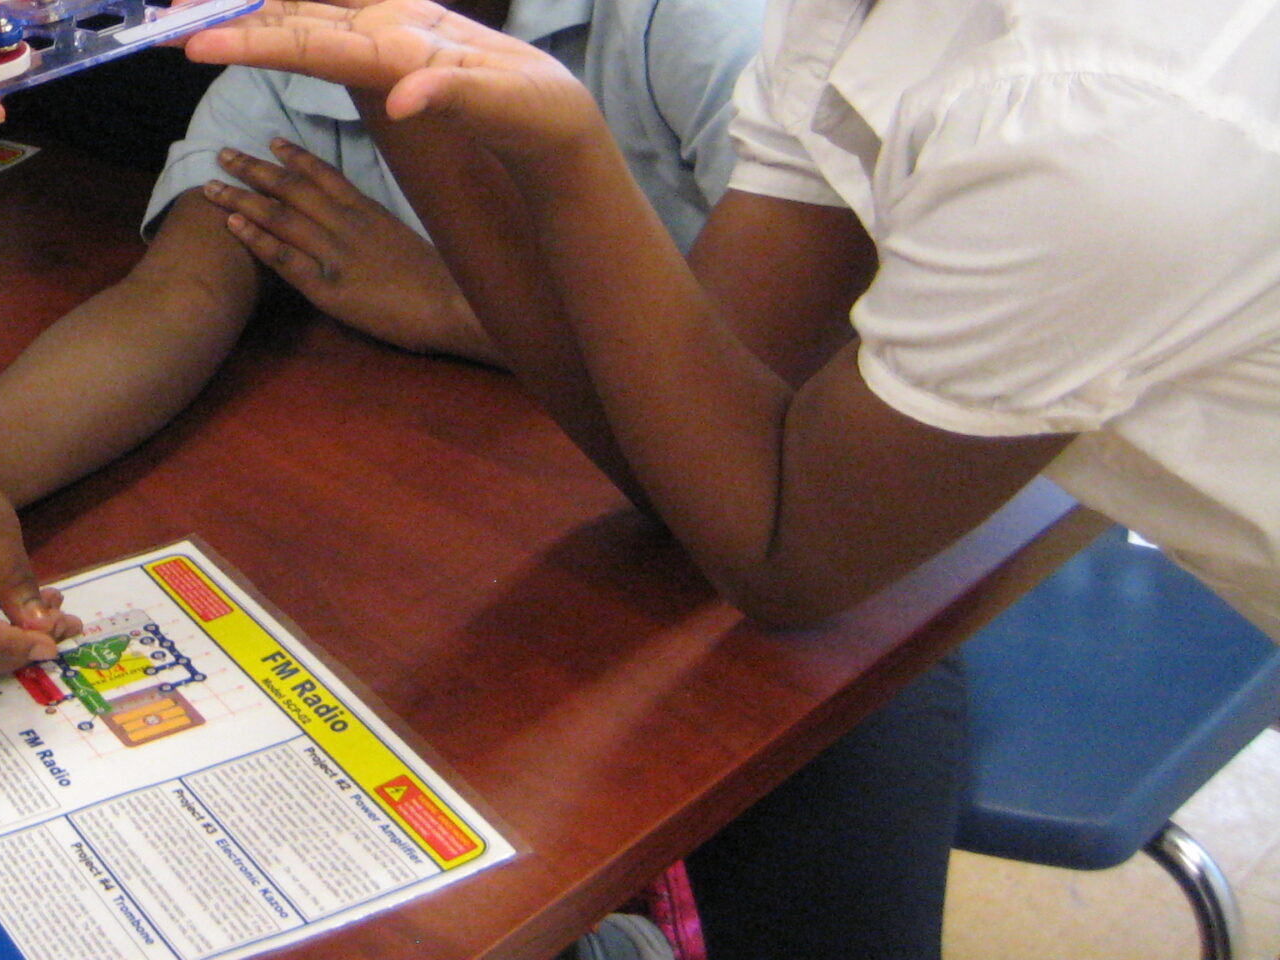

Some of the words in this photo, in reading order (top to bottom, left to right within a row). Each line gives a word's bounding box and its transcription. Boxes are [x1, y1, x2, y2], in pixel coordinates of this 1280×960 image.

[261, 651, 300, 680] FM
[291, 679, 348, 732] Radio
[262, 678, 285, 699] Model
[283, 699, 312, 725] SCP-02
[19, 729, 44, 748] FM
[36, 749, 70, 786] Radio
[304, 747, 338, 778] Project
[336, 779, 351, 791] #2
[350, 794, 380, 821] Power
[379, 824, 422, 863] Amplifier
[71, 840, 103, 877] Project
[99, 878, 115, 891] #4
[114, 892, 154, 944] Trombone
[173, 788, 205, 821] Project
[202, 822, 217, 834] #3
[216, 838, 260, 886] Electronic
[259, 888, 288, 918] Kazoo
